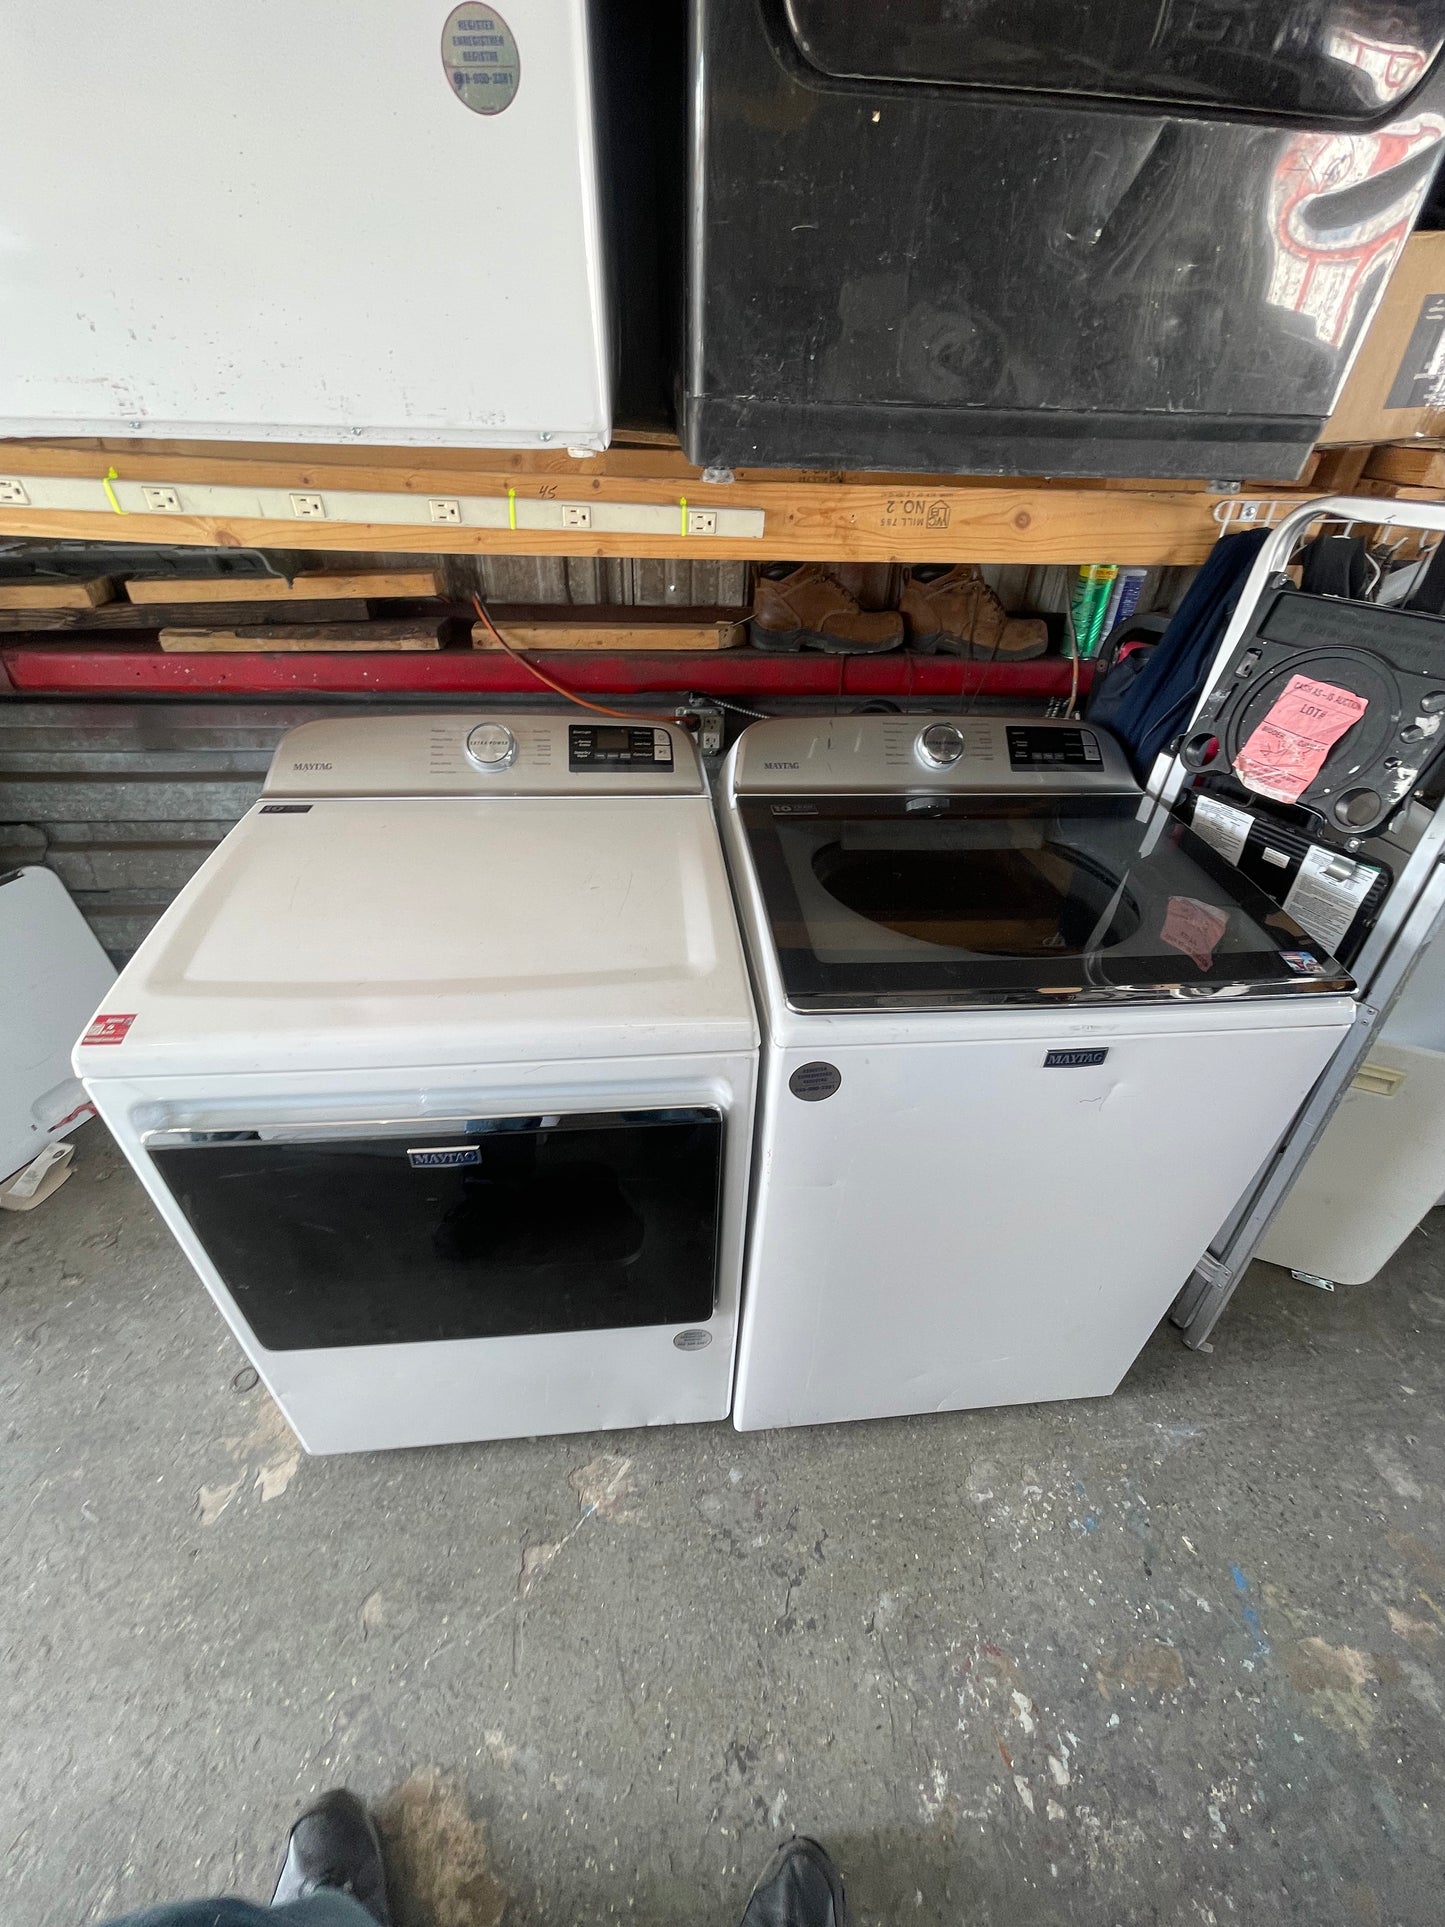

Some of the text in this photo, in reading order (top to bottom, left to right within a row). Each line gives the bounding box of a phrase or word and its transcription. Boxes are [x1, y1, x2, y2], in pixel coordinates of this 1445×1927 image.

[539, 485, 558, 499] 45
[886, 500, 925, 514] NO. 2
[900, 517, 925, 527] MILL
[1293, 682, 1313, 694] CASH
[1300, 704, 1327, 719] LOT#
[294, 762, 332, 770] MAYTAG
[764, 762, 800, 770] MAYTAG
[1047, 1053, 1103, 1064] MAYTAG
[415, 1152, 476, 1164] MAYTAG
